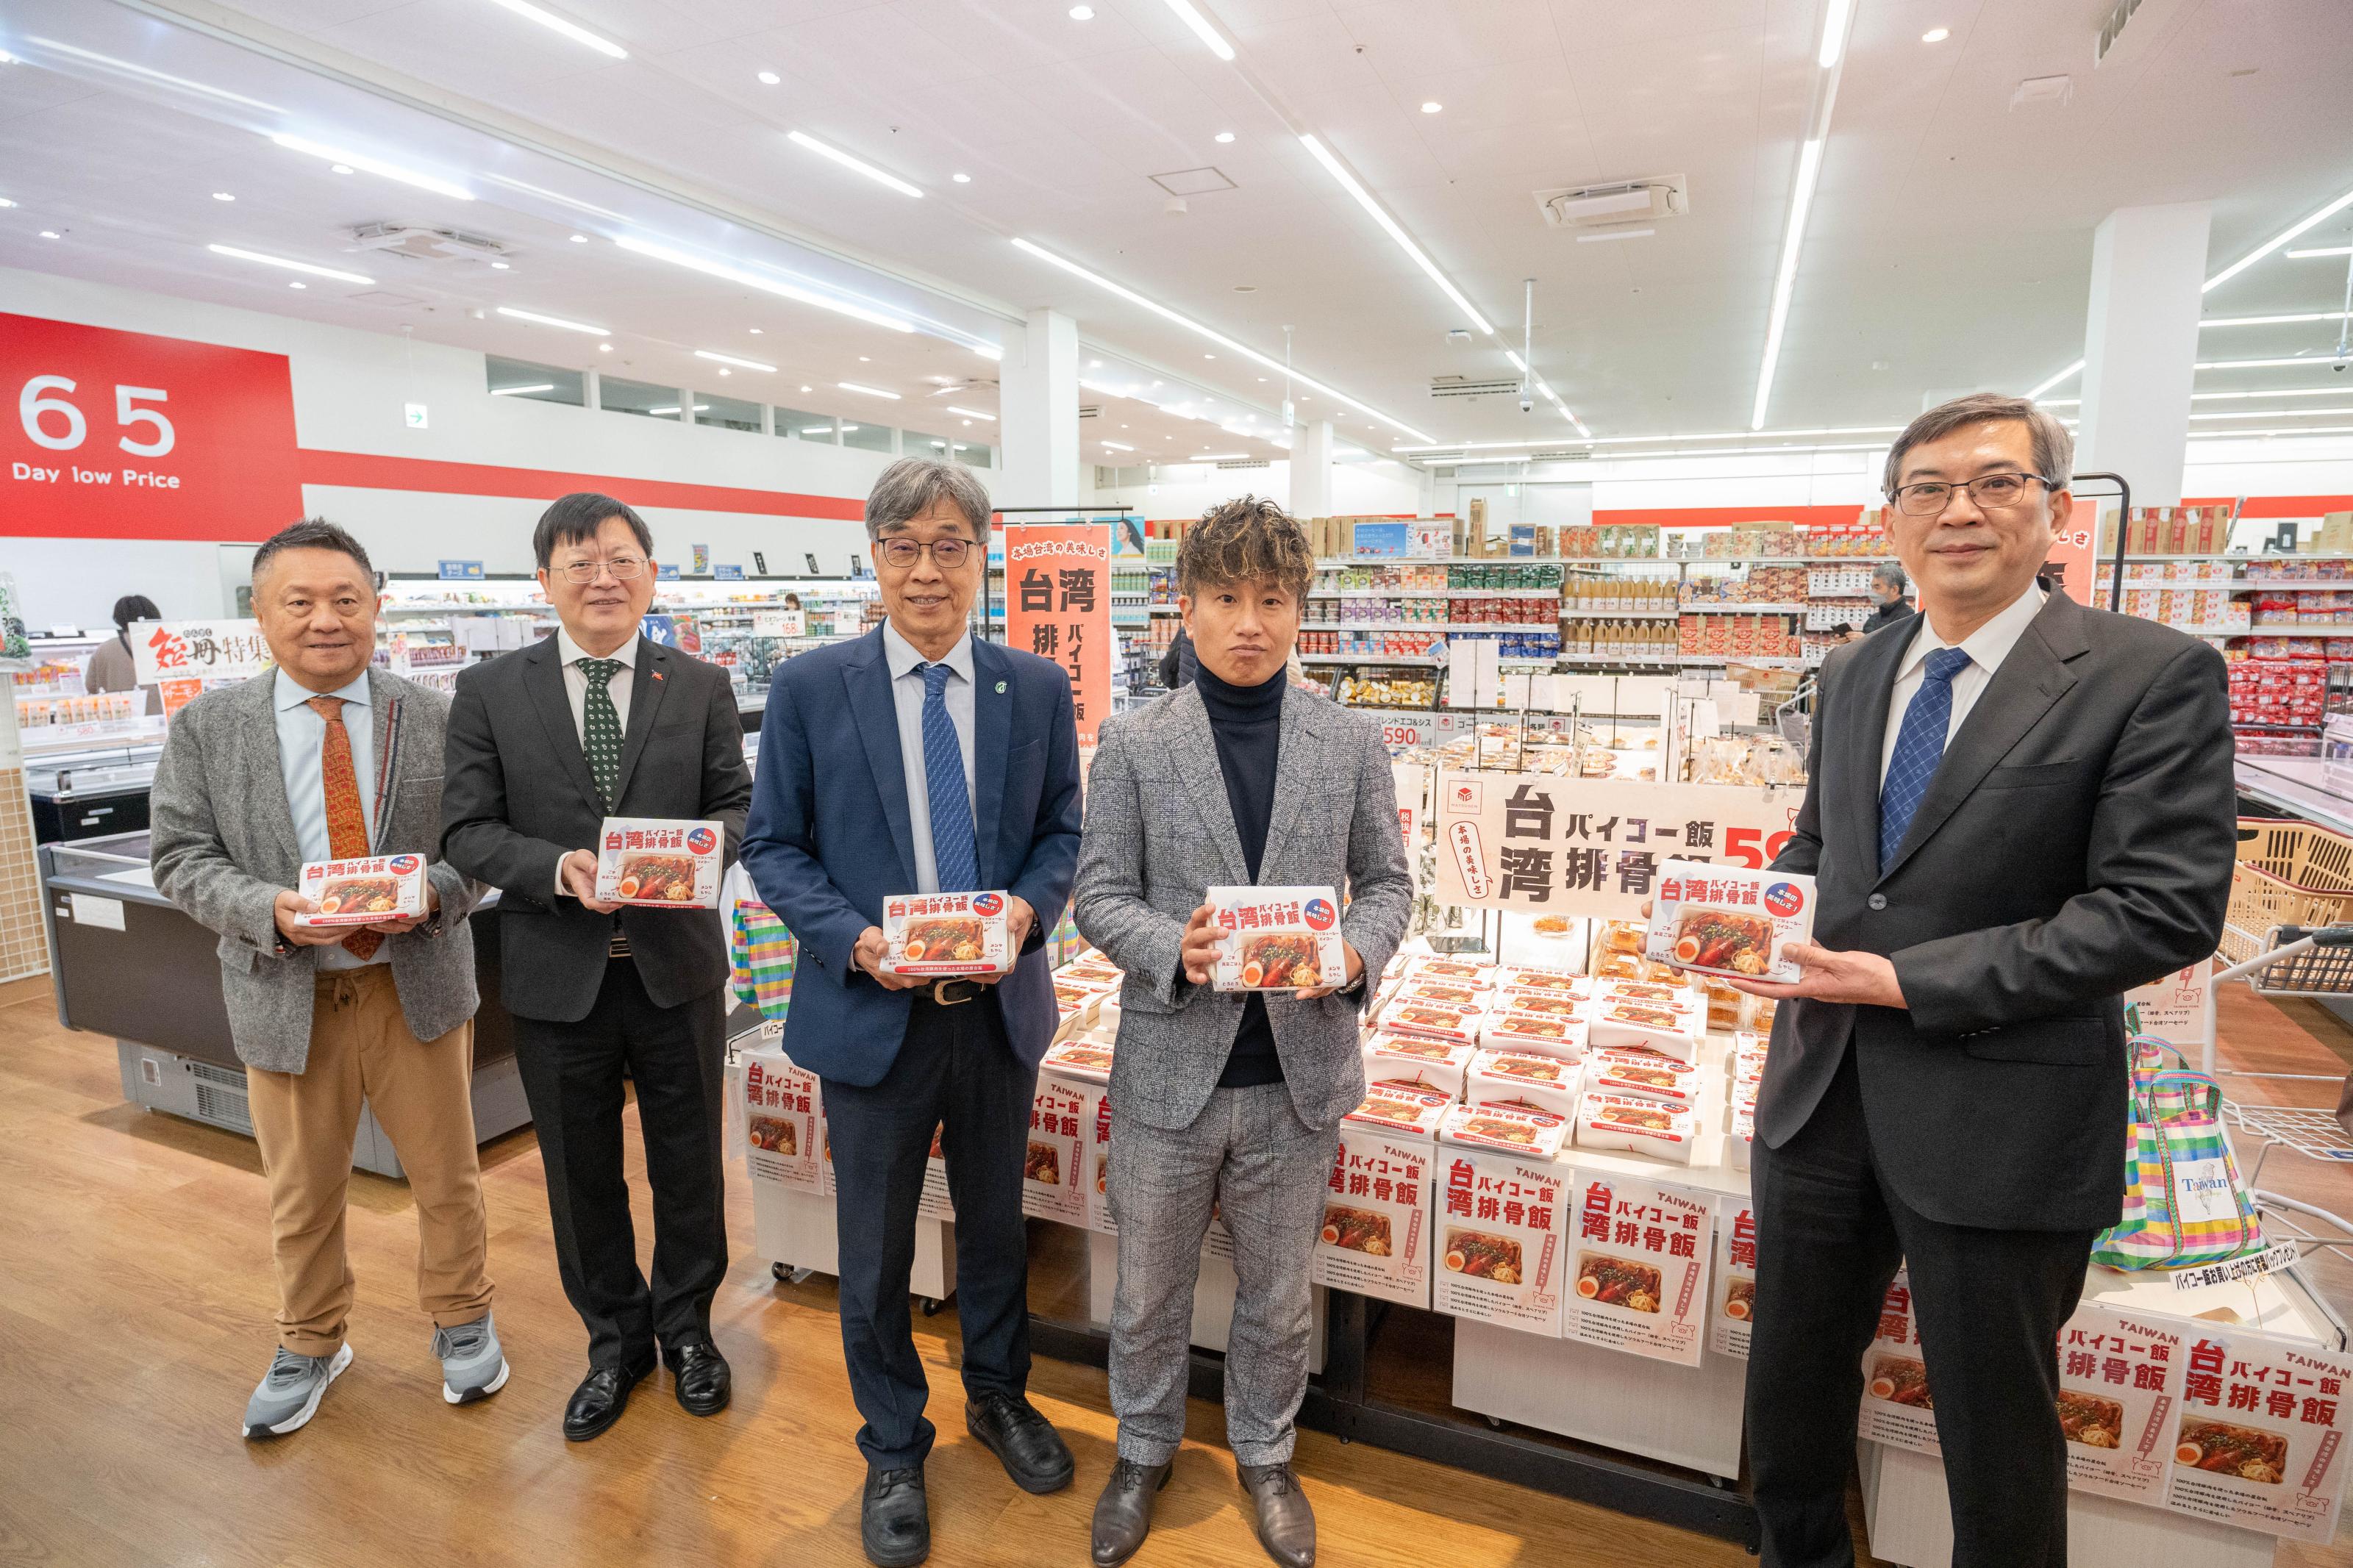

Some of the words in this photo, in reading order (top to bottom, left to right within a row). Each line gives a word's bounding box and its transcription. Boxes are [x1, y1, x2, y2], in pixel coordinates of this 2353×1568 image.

[19, 374, 87, 450] 6
[115, 385, 175, 457] 5
[12, 463, 60, 482] Day
[71, 466, 111, 484] low
[123, 469, 179, 489] Price
[1013, 541, 1106, 559] 本場台湾の美味しさ
[1020, 568, 1096, 612] 台湾
[782, 623, 796, 634] 168
[149, 626, 271, 671] 短冊特集
[1384, 727, 1416, 745] 590
[646, 828, 684, 837] パイコー飯
[1400, 811, 1411, 831] 税抜
[1565, 813, 1715, 848] パイコー飯
[606, 831, 643, 850] 台湾
[645, 837, 682, 848] 排骨飯
[1499, 784, 1556, 903] 台湾
[346, 863, 385, 875] 排骨飯
[1458, 825, 1482, 894] 本場の美味しさ
[307, 863, 346, 880] 台湾
[1661, 878, 1708, 902] 台湾
[1710, 879, 1760, 890] パイコー飯
[1777, 889, 1798, 902] 本場の
[888, 899, 929, 918] 台湾
[929, 895, 968, 903] パイコー飯
[929, 901, 968, 914] 排骨飯
[1259, 901, 1299, 913] パイコー飯
[1709, 889, 1757, 905] 排骨飯
[1217, 906, 1260, 931] 台湾
[1260, 910, 1300, 927] 排骨飯
[1313, 905, 1329, 914] 本場の
[765, 1075, 812, 1093] パイコー飯
[788, 1067, 815, 1082] TAIWAN
[766, 1089, 810, 1114] 排骨飯
[1051, 1084, 1085, 1101] TAIWAN
[1384, 1145, 1426, 1166] TAIWAN
[1349, 1154, 1420, 1181] パイコー飯
[1515, 1166, 1561, 1188] TAIWAN
[1349, 1173, 1418, 1206] 排骨飯
[1446, 1159, 1474, 1218] 台湾
[1477, 1176, 1554, 1204] パイコー飯
[2182, 1178, 2228, 1192] Taiwan
[1477, 1196, 1553, 1231] 排骨飯
[1581, 1181, 1613, 1242] 台湾
[1657, 1192, 1707, 1215] TAIWAN
[1615, 1200, 1699, 1231] パイコー飯
[1615, 1220, 1697, 1259] 排骨飯
[2118, 1320, 2179, 1346] TAIWAN
[2068, 1329, 2170, 1363] パイコー飯
[2066, 1350, 2168, 1393] 排骨飯
[2183, 1339, 2227, 1407] 台湾
[2285, 1352, 2352, 1379] TAIWAN
[2229, 1361, 2342, 1397] パイコー飯
[2227, 1383, 2338, 1428] 排骨飯
